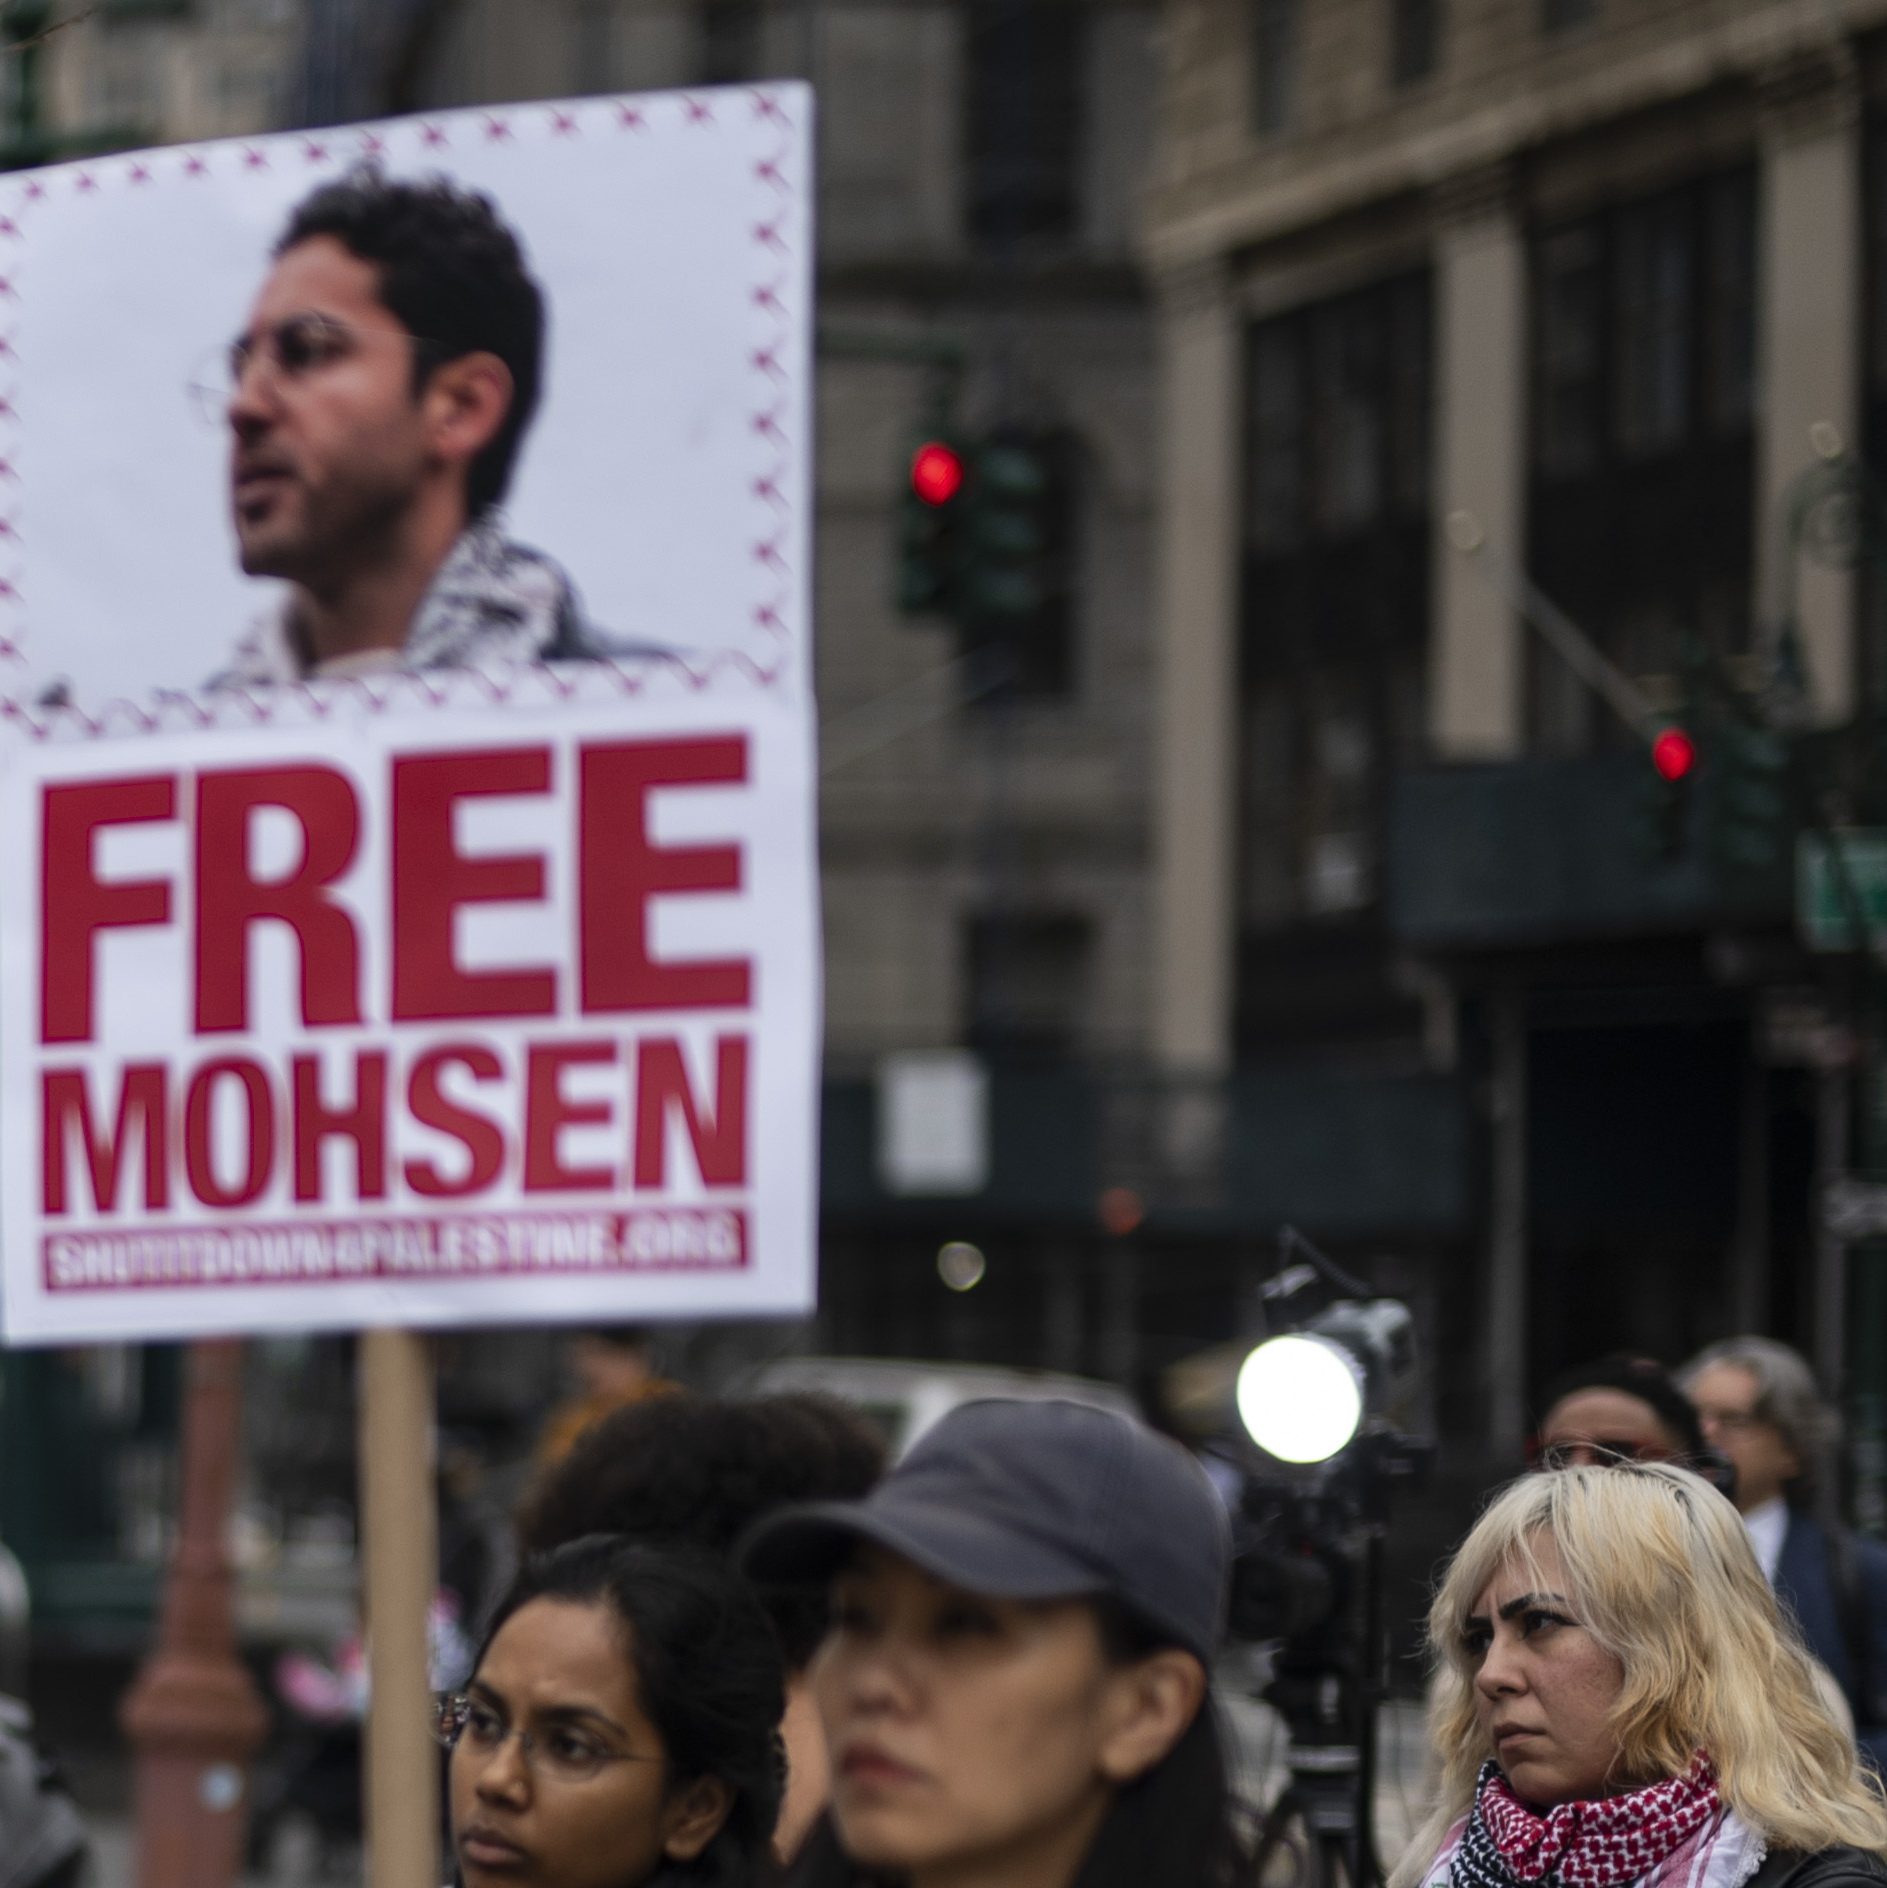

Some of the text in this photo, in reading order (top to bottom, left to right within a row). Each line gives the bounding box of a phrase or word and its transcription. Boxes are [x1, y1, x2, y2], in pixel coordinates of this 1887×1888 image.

[37, 733, 753, 1045] FREE
[39, 1034, 750, 1218] MOHSEN
[51, 1213, 741, 1287] SHUTITDOWN4PALESTINE.ORG
